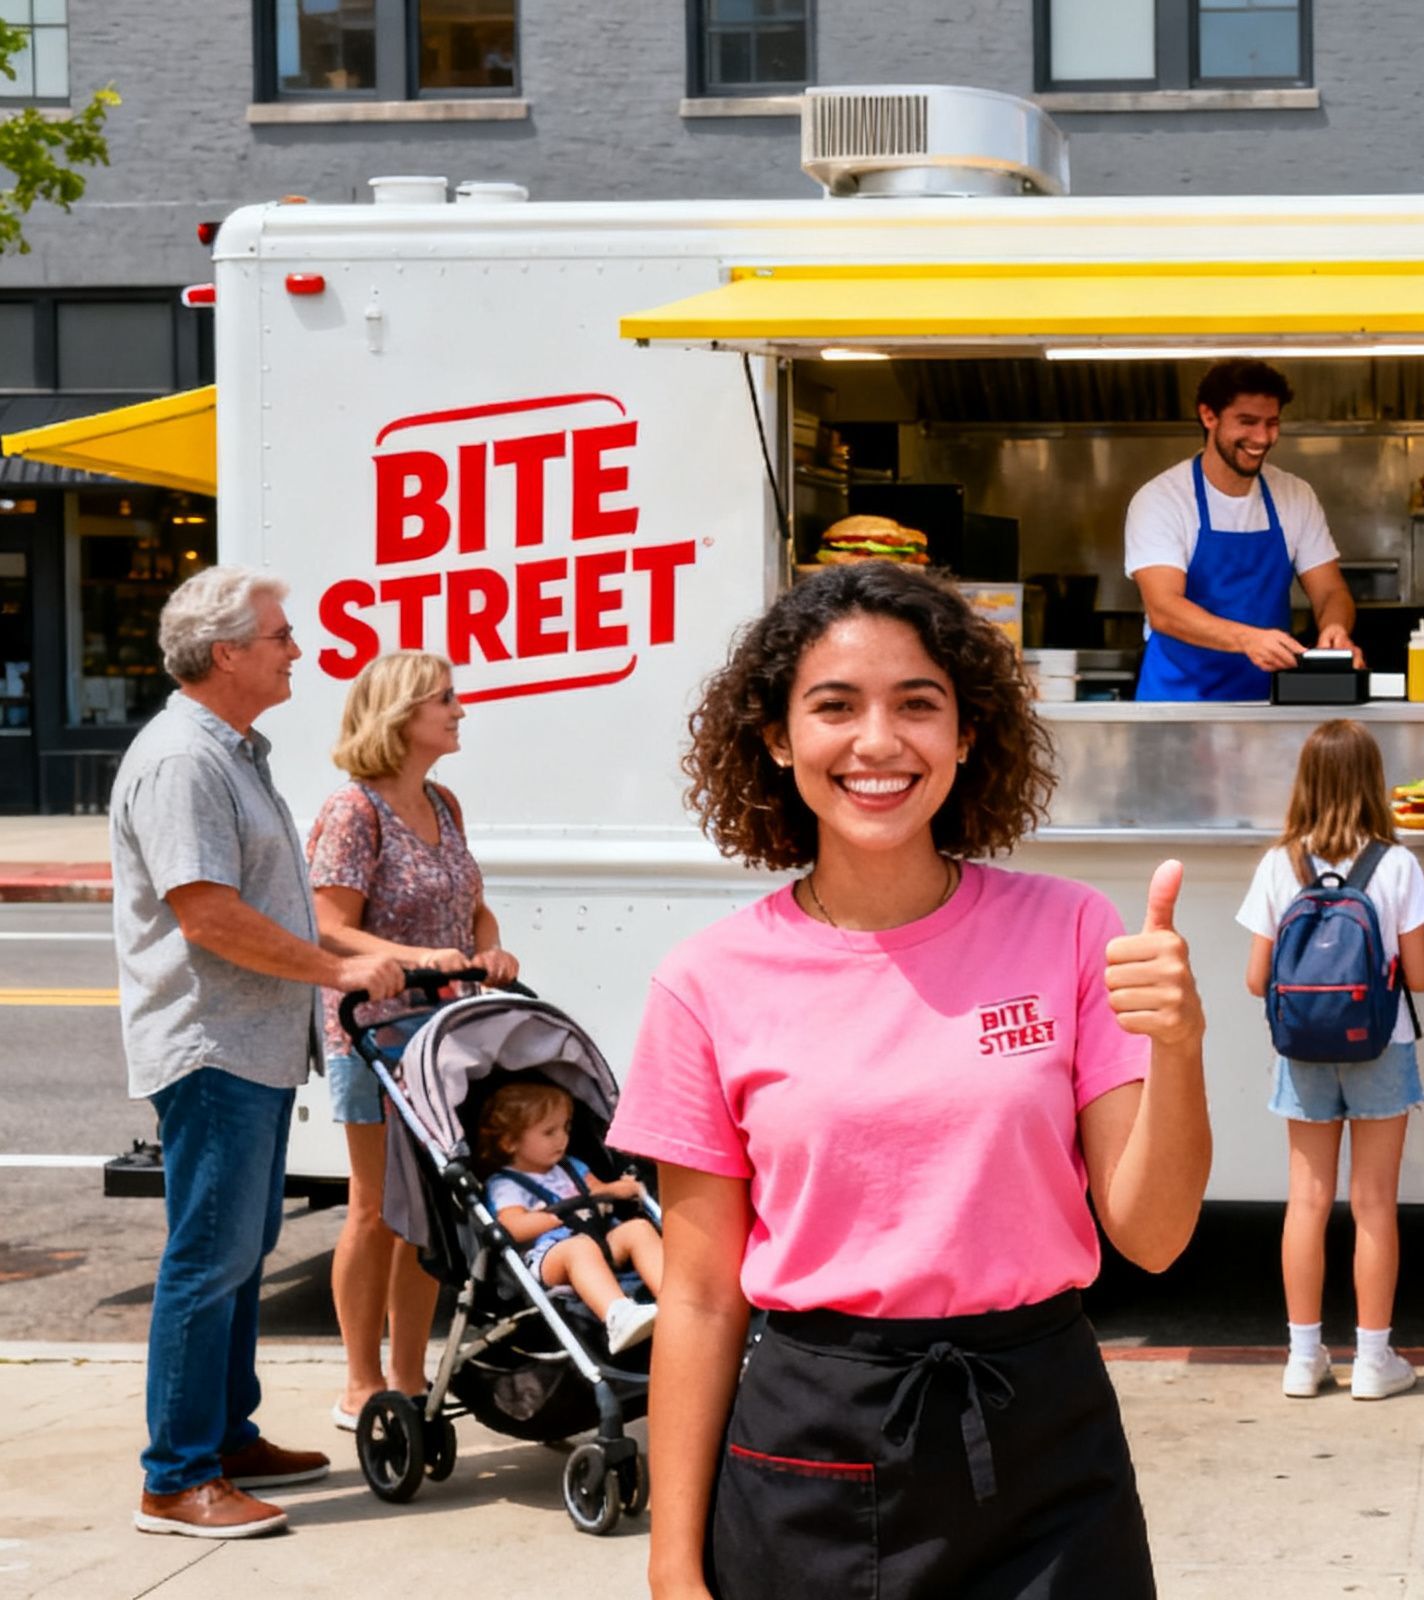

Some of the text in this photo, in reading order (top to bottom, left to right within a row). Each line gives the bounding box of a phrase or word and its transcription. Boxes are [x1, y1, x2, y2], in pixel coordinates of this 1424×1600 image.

[372, 420, 640, 566] BITE
[318, 539, 696, 680] STREET
[980, 1001, 1038, 1032] BITE
